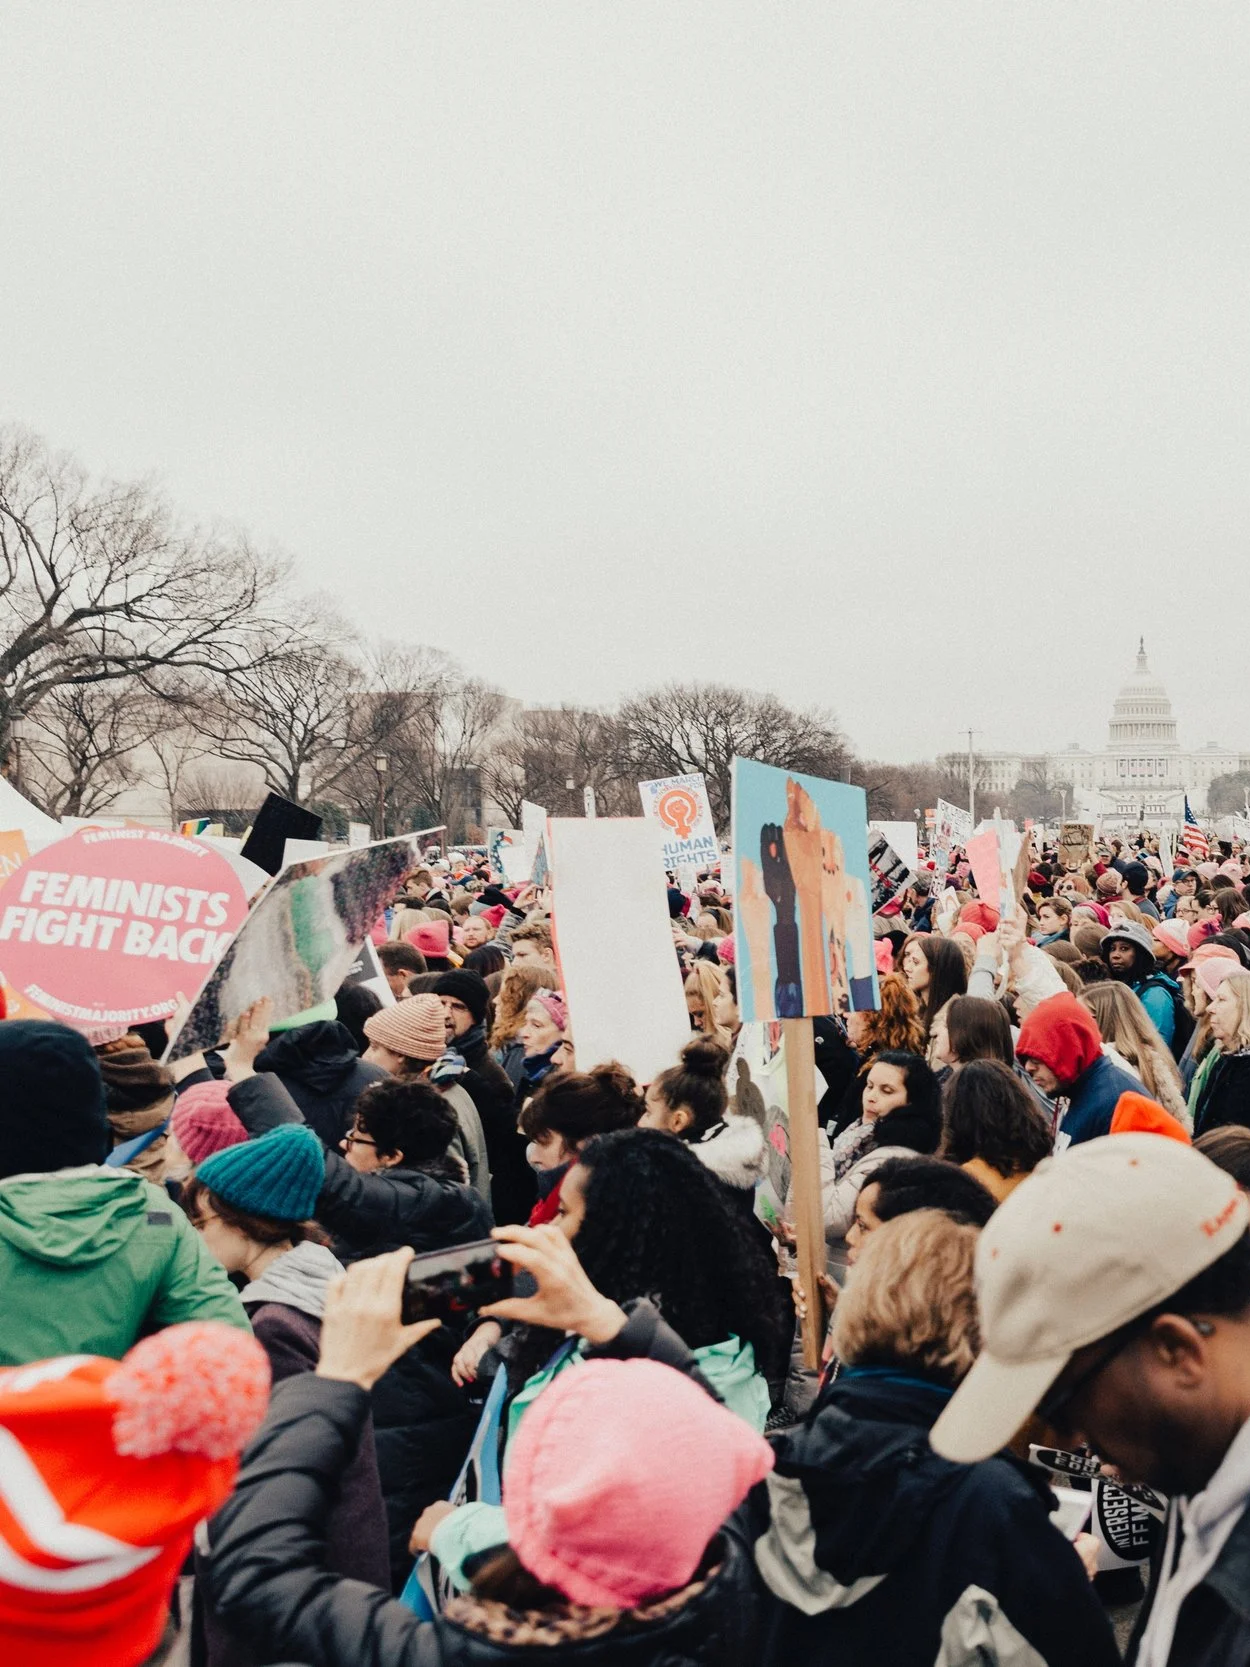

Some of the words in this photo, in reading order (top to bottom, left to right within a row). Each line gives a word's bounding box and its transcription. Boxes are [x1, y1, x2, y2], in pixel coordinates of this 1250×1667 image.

[19, 870, 231, 927] FEMINISTS
[0, 905, 123, 951] FIGHT
[123, 920, 235, 964] BACK
[1102, 1484, 1131, 1549] INTERSECT
